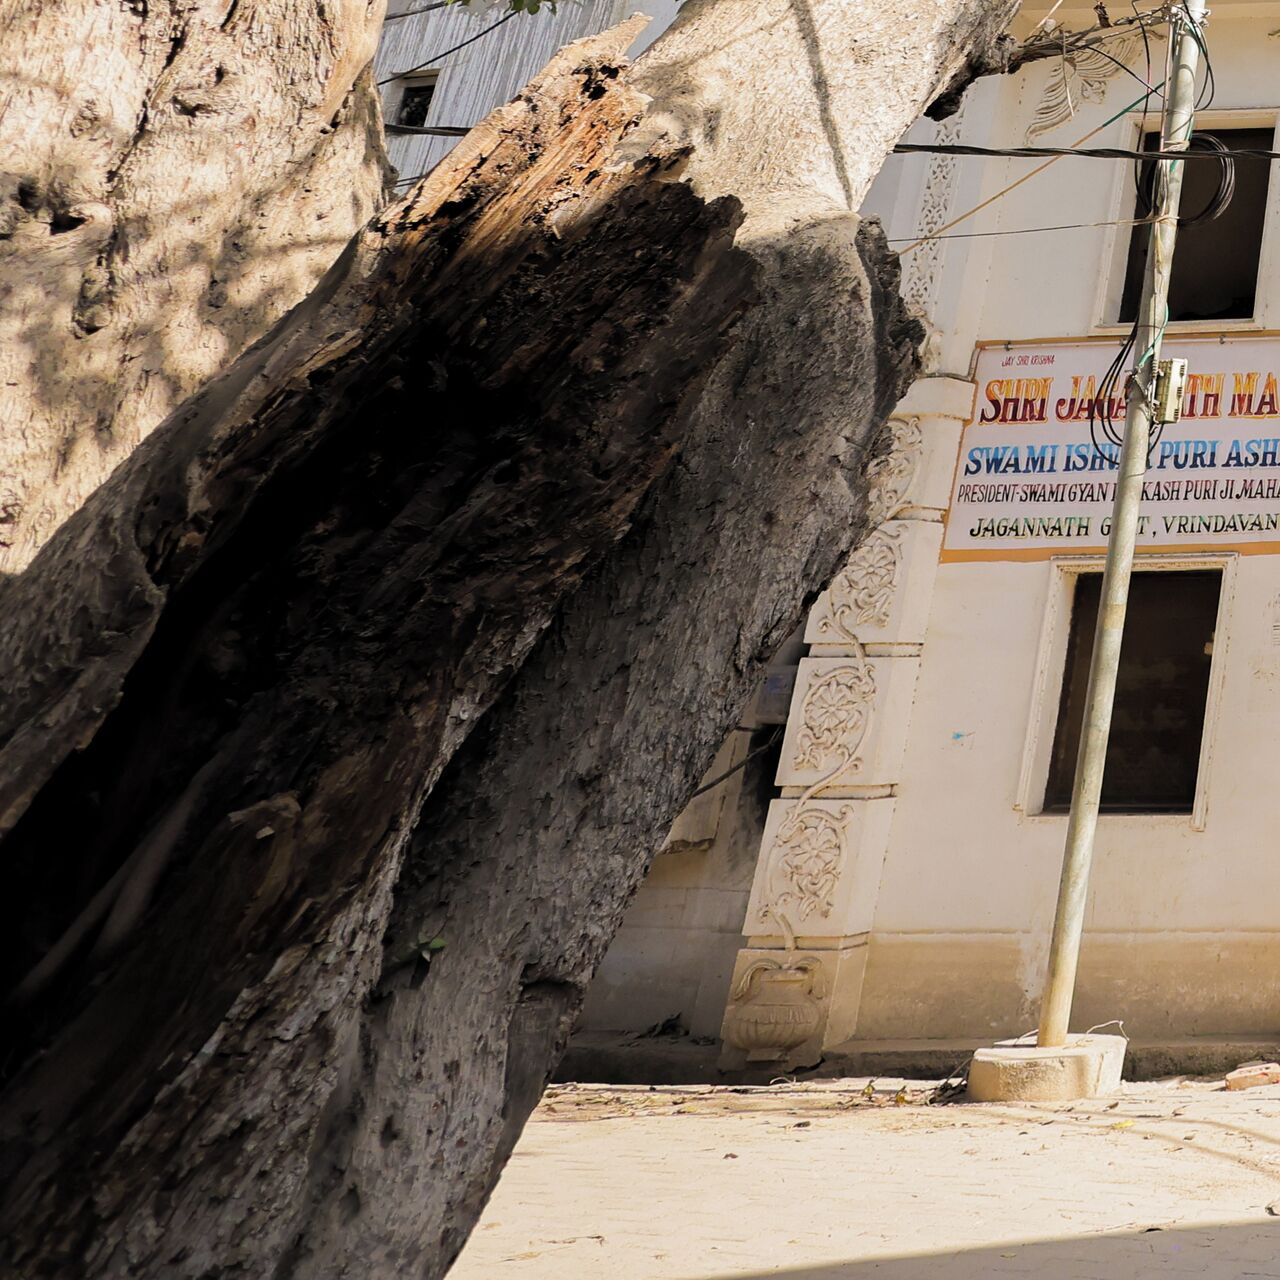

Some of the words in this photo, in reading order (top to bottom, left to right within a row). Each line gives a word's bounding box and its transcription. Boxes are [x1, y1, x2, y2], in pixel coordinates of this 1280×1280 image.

[979, 377, 1053, 425] SHRI
[965, 444, 1060, 476] SWAMI
[1157, 439, 1223, 470] PURI
[1068, 481, 1108, 502] GYAN
[1183, 479, 1219, 500] PURI
[1220, 478, 1235, 500] JI
[970, 516, 1092, 538] JAGANNATH
